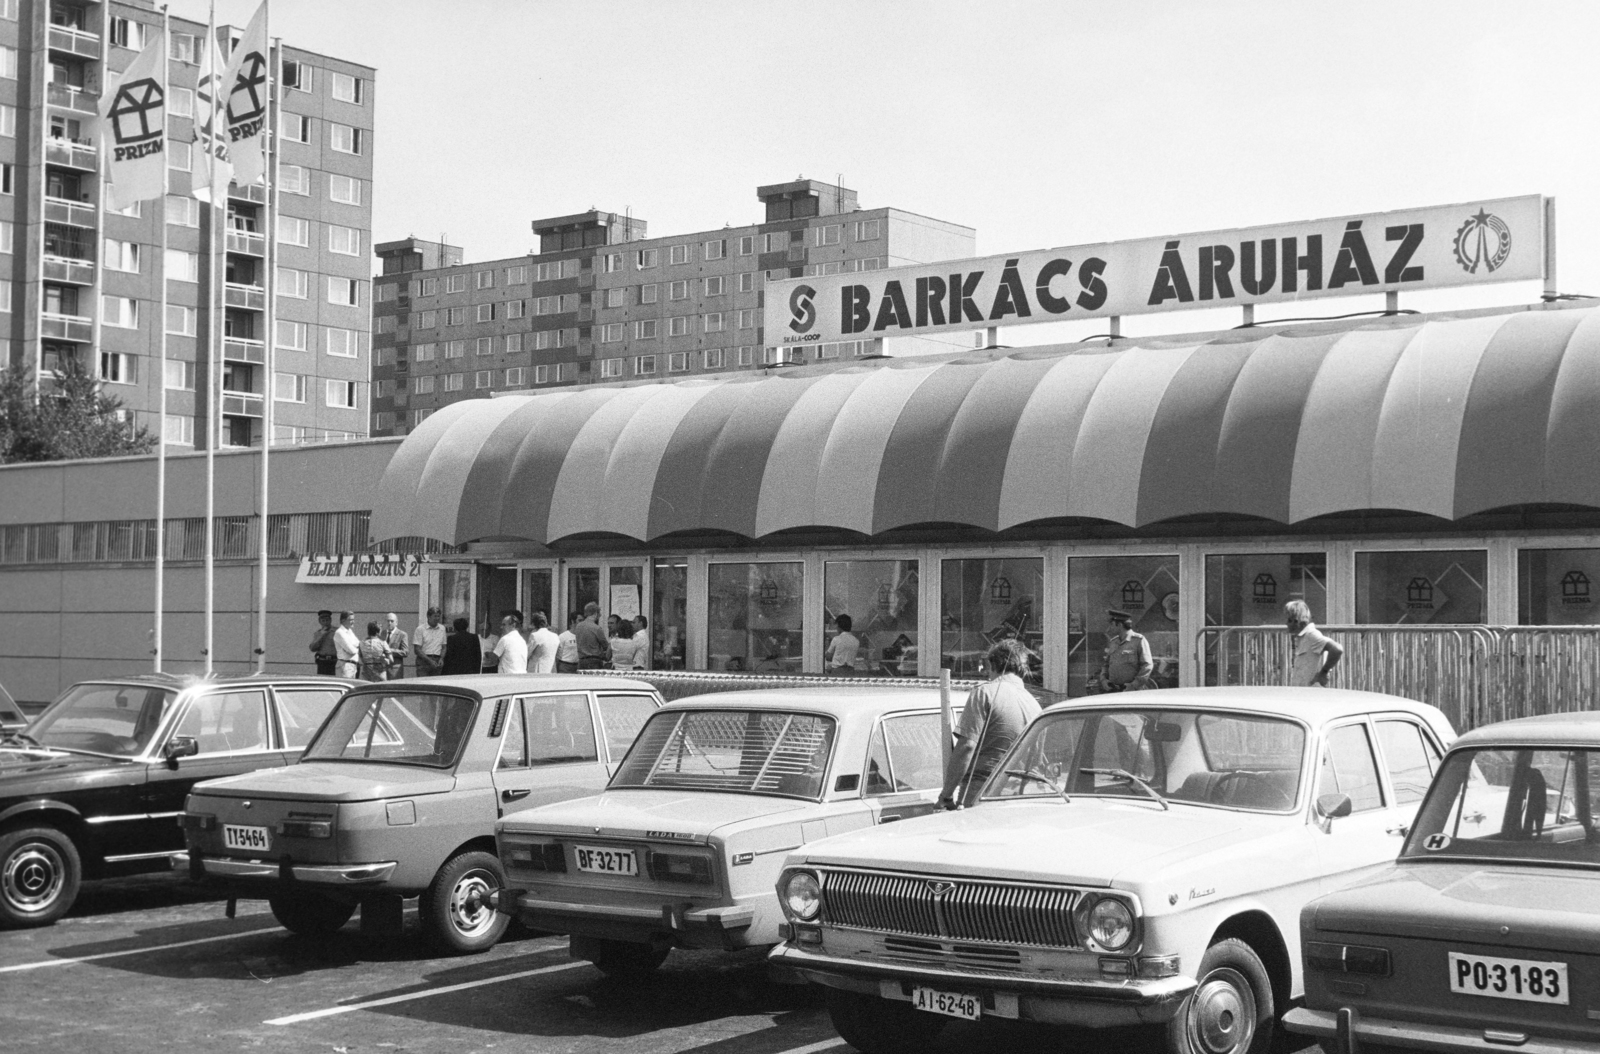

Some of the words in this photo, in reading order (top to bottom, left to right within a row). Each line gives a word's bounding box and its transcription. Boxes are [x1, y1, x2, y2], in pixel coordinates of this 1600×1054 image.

[114, 138, 163, 162] PRIZM
[841, 257, 1108, 334] BARKÁCS
[1147, 220, 1424, 306] ÁRUHÁZ
[346, 561, 406, 577] AUGUSZTUS
[1426, 835, 1446, 849] H
